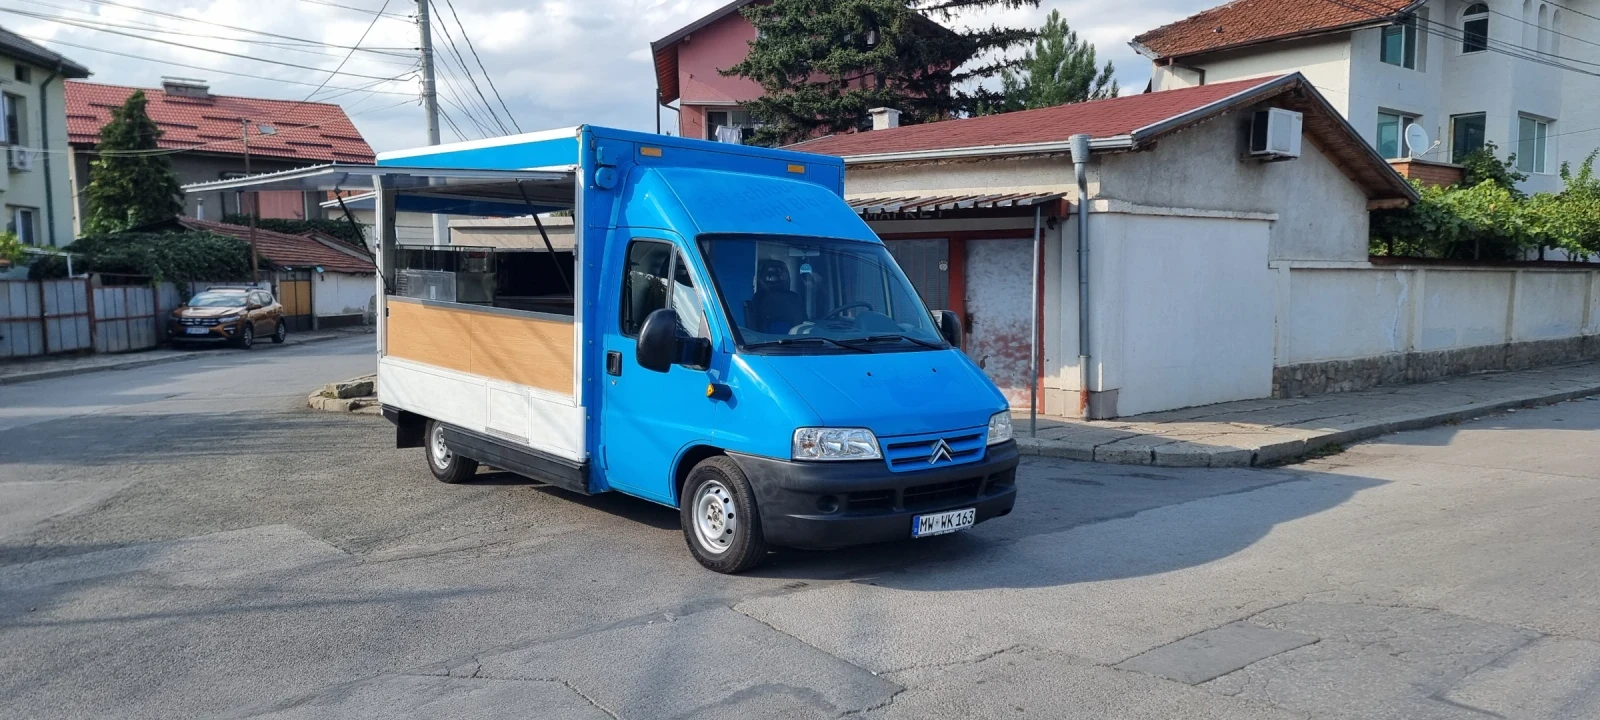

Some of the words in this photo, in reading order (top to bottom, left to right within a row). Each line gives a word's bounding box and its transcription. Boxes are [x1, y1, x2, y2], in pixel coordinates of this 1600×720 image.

[920, 517, 935, 532] MW
[941, 513, 955, 529] WK
[956, 510, 974, 526] 163
